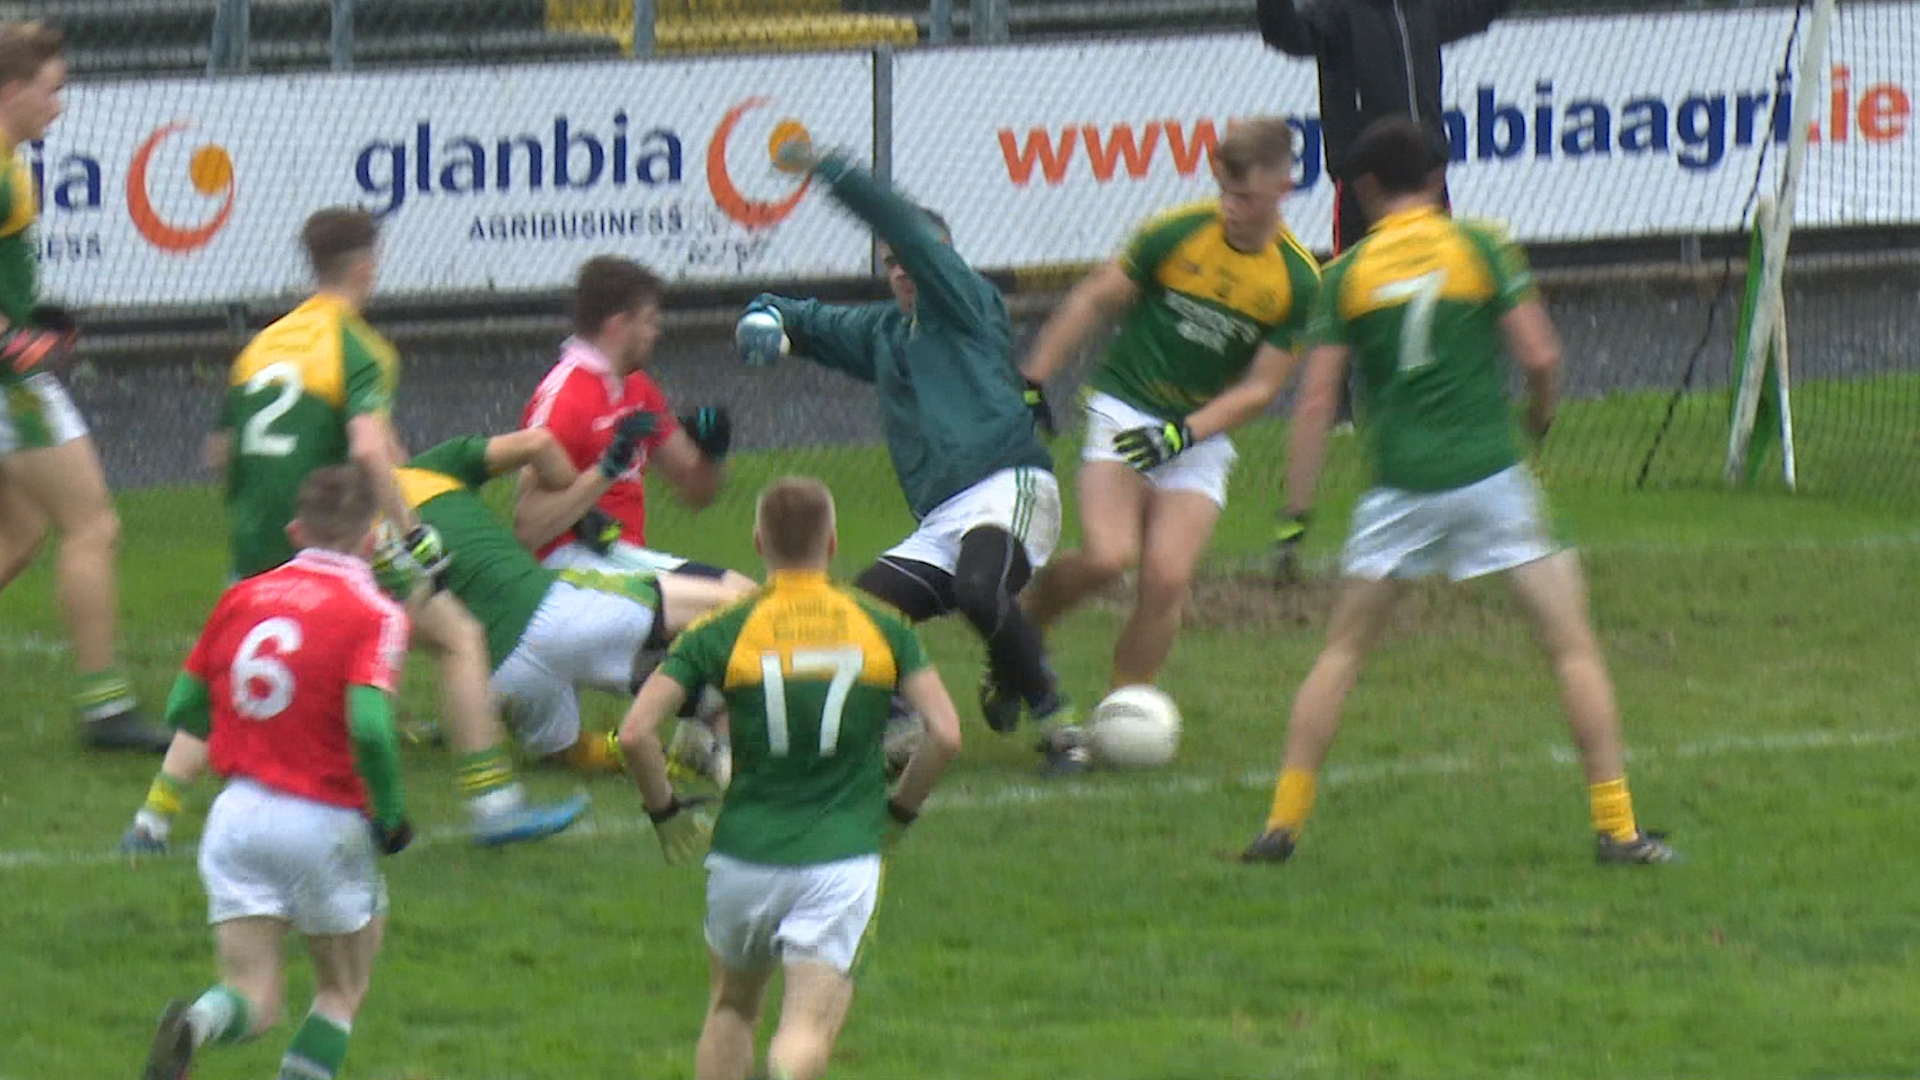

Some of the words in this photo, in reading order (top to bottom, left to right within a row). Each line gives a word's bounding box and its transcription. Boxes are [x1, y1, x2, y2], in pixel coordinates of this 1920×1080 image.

[355, 109, 683, 220] glanbia
[469, 202, 683, 241] AGRIBUSINESS
[1370, 266, 1449, 372] 7
[242, 361, 303, 456] 2
[231, 616, 303, 721] 6
[761, 648, 863, 759] 17
